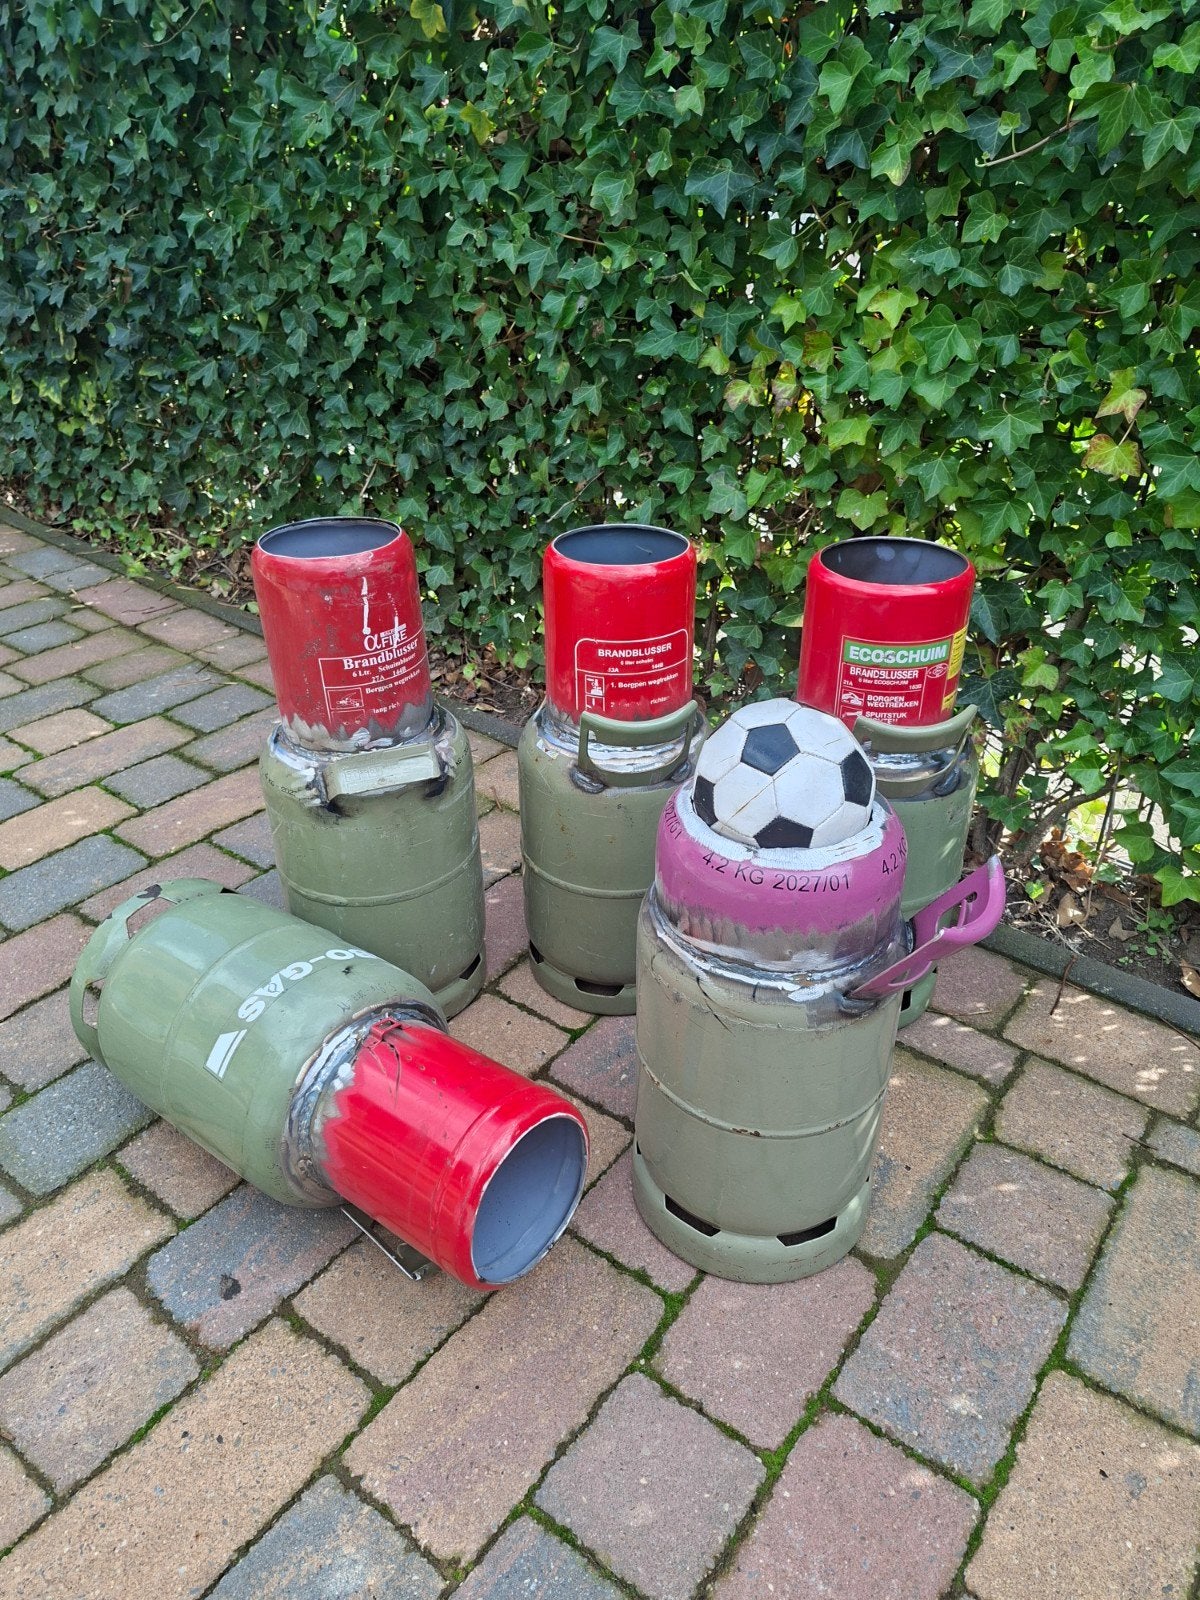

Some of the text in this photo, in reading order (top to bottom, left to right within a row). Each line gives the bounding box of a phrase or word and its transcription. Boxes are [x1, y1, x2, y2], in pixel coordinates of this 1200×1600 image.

[342, 638, 418, 671] Brandblusser
[597, 642, 672, 658] BRANDBLUSSER
[849, 644, 948, 664] ECOSCHUIM
[849, 666, 919, 680] BRANDBLUSSER
[618, 681, 647, 690] Borgpen
[867, 694, 905, 702] BORGPEN
[867, 700, 919, 709] WEGTREKKEN
[865, 711, 907, 719] SPUITSTUK
[882, 853, 899, 875] 4.2
[702, 851, 850, 893] 4.2 KG 2027/01
